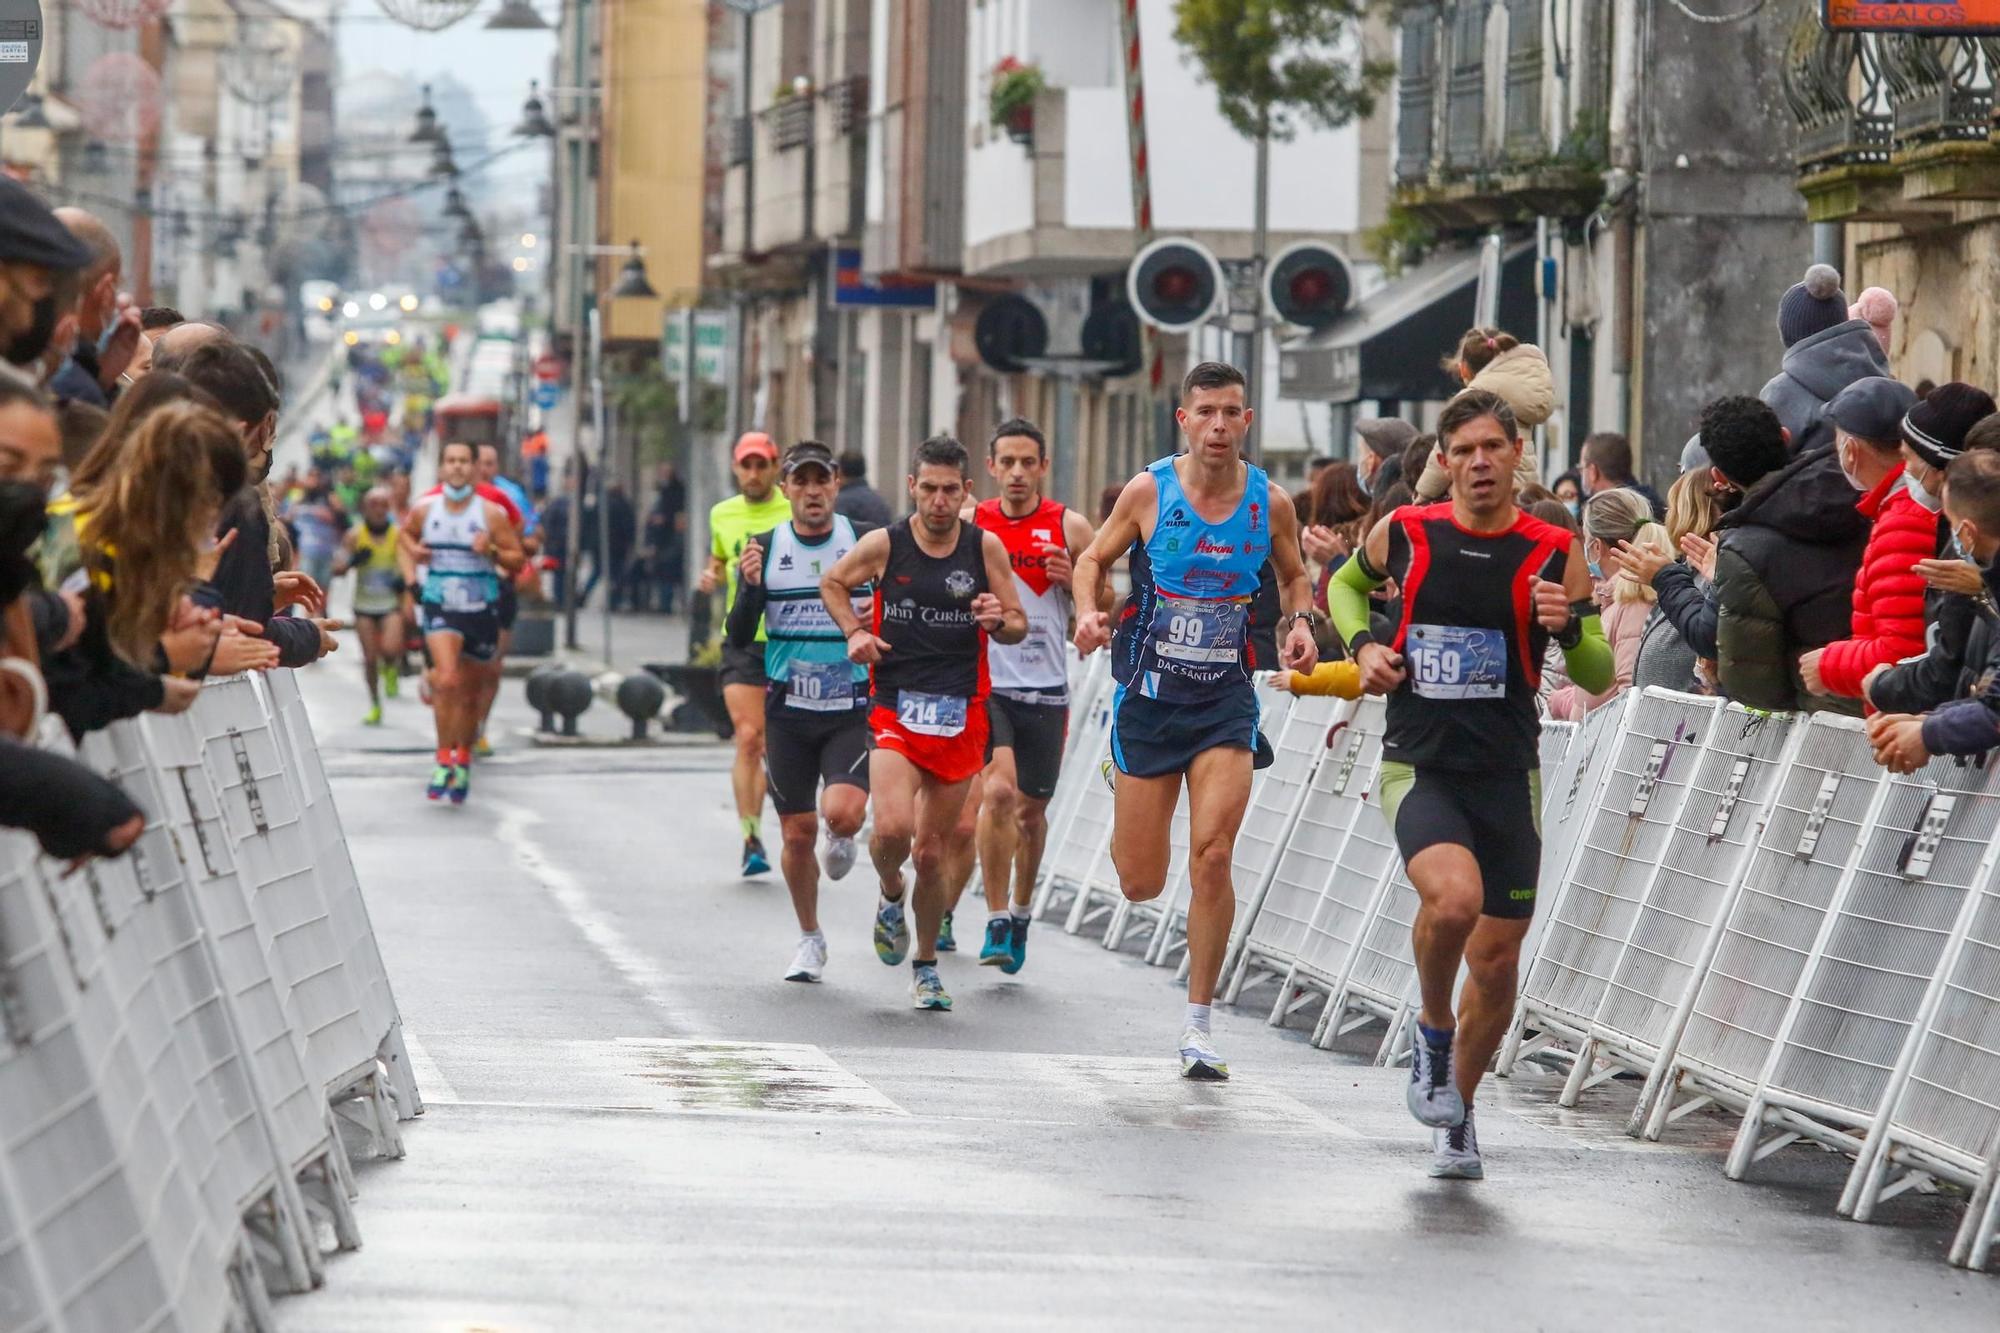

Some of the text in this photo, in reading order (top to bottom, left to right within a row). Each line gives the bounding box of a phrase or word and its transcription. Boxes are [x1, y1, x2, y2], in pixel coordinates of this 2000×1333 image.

[1832, 6, 1966, 22] REGALOS
[883, 601, 913, 620] John
[1168, 615, 1204, 647] 99
[1156, 658, 1179, 674] DAC
[1410, 647, 1461, 684] 159
[791, 675, 821, 699] 110
[901, 700, 937, 724] 214
